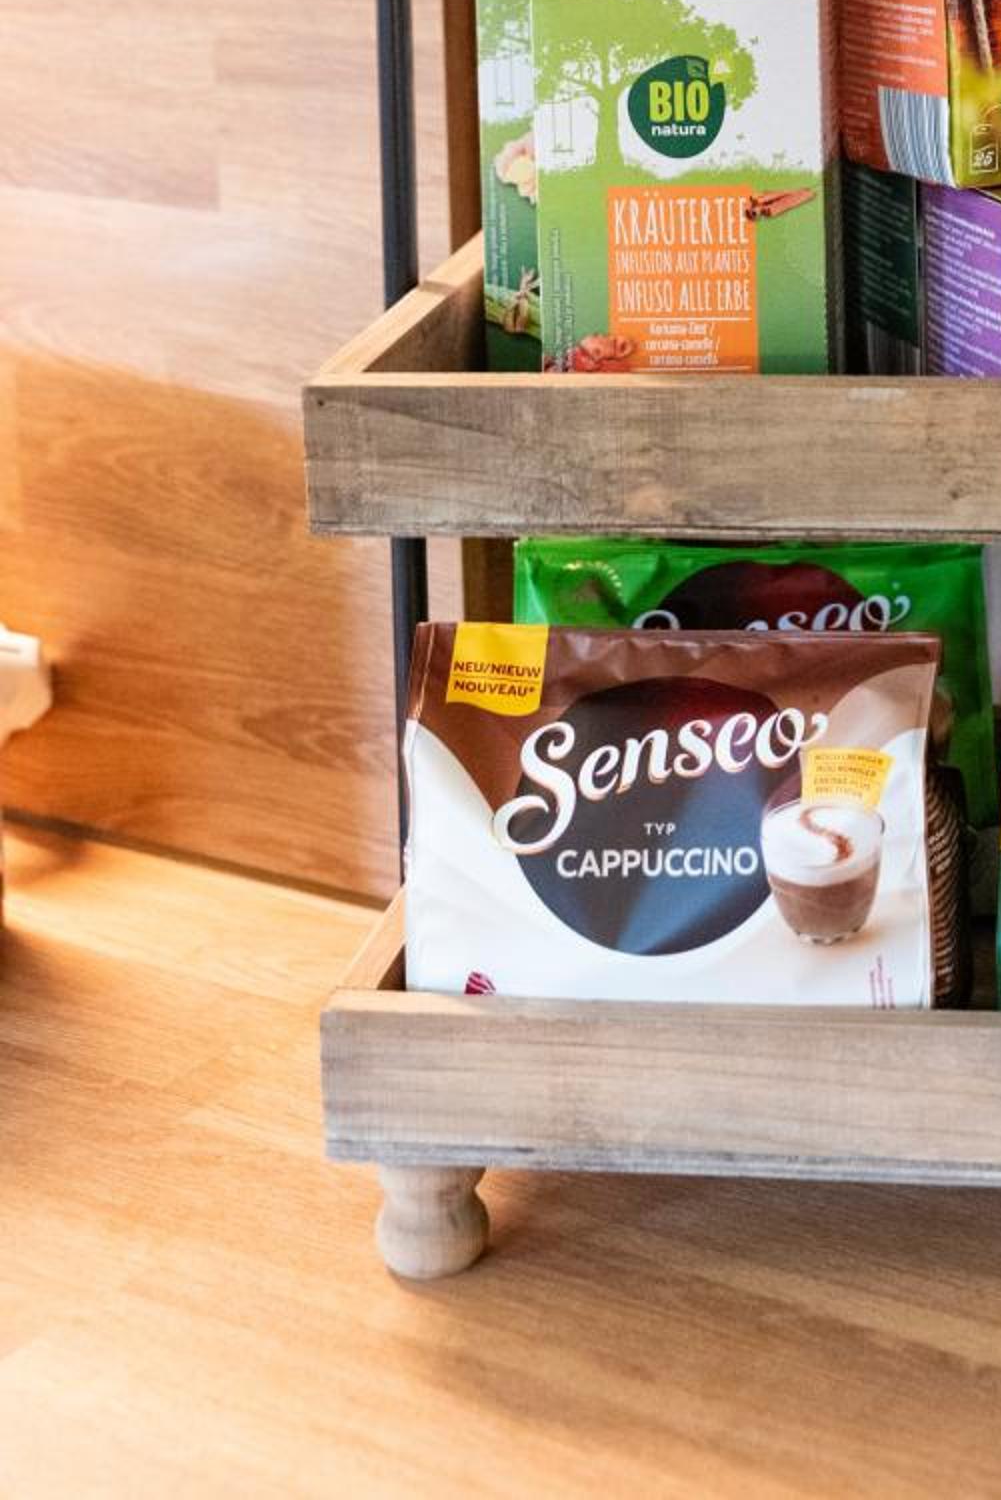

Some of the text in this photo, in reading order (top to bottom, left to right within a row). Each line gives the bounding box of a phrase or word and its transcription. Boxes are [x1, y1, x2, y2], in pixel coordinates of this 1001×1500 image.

[648, 78, 709, 122] BIO
[651, 122, 707, 137] natura
[613, 191, 750, 245] KRÄUTERTEE
[616, 278, 750, 314] INFUSO ALLE ERBE
[453, 660, 541, 678] NEU/NIEUW
[491, 707, 829, 855] Senseo
[643, 822, 677, 836] TYP
[556, 847, 759, 880] CAPPUCCINO
